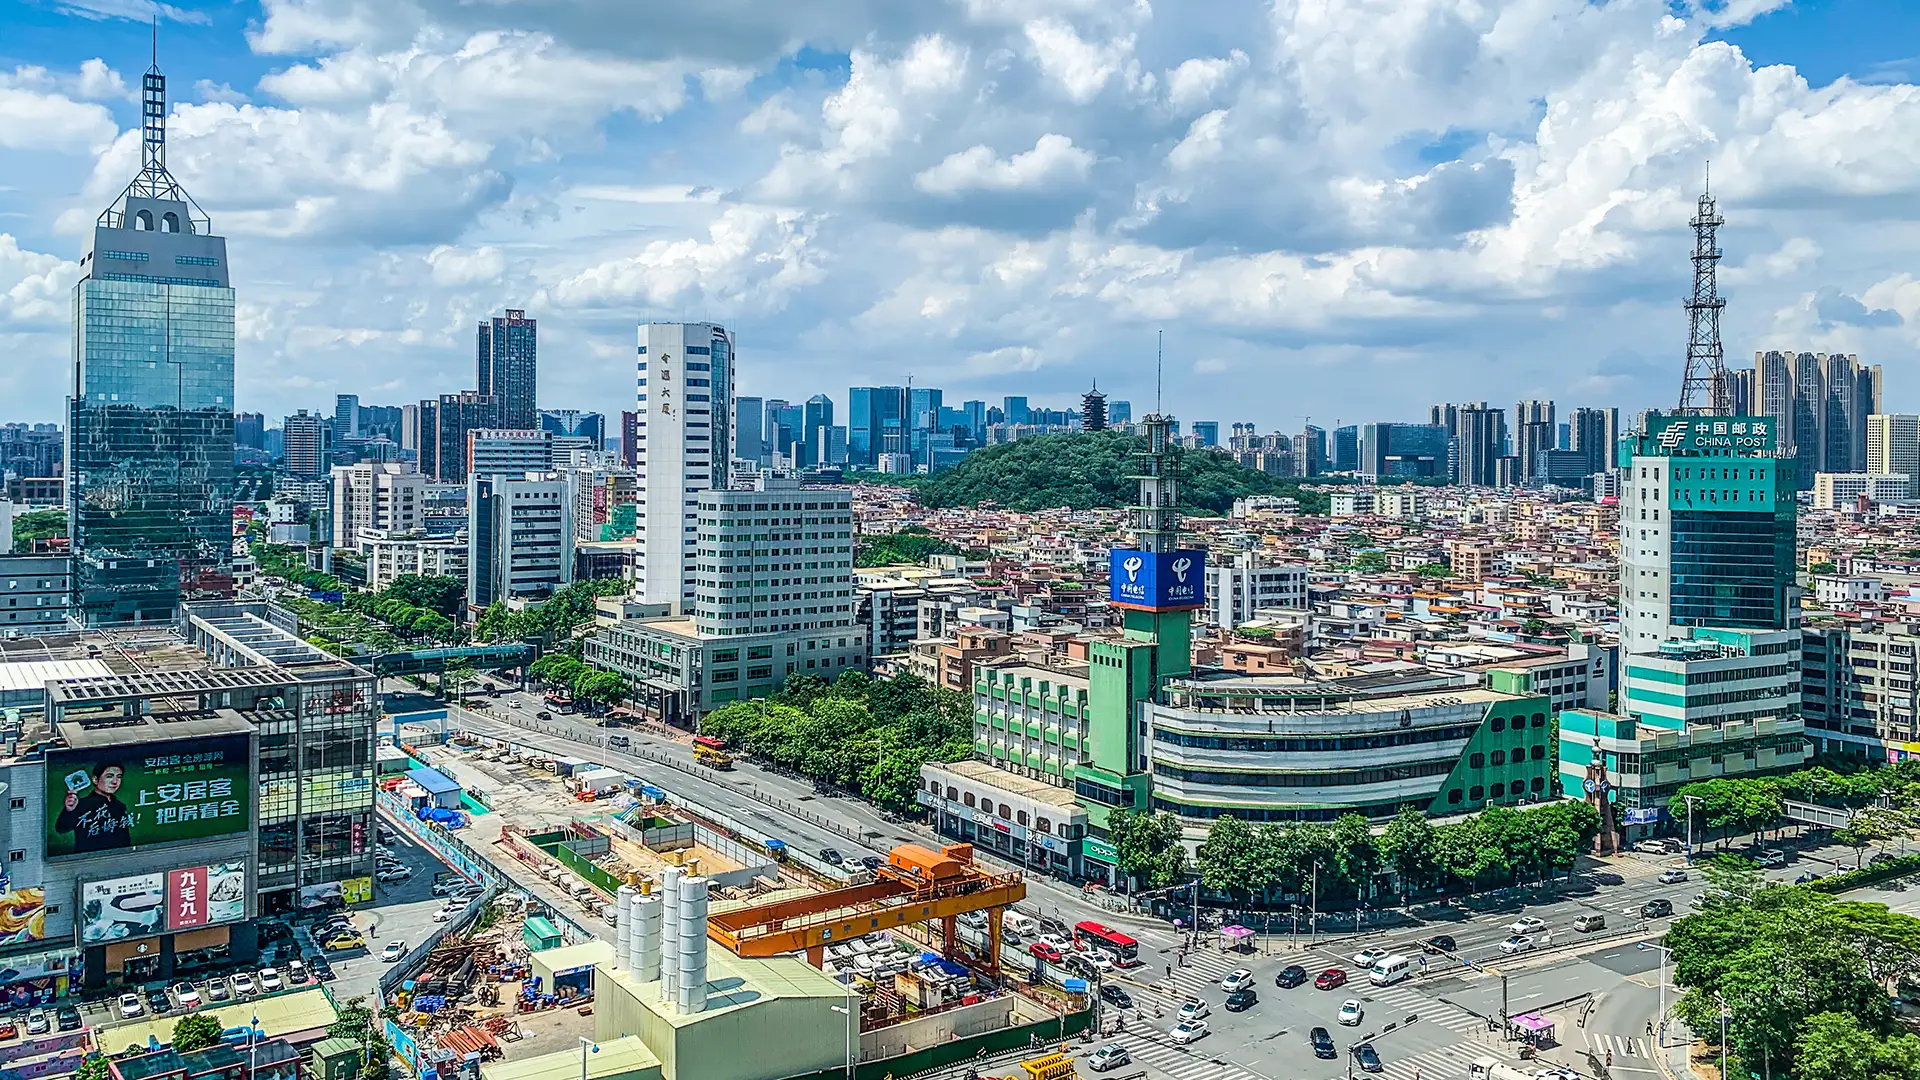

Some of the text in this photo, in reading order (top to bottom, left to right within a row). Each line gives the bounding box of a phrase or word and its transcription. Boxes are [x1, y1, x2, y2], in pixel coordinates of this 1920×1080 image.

[1695, 421, 1768, 436] 中国邮政
[1695, 437, 1768, 447] CHINA POST
[1120, 582, 1145, 596] 中国电信
[1168, 584, 1194, 599] 中国电信
[134, 777, 232, 807] 上安居客
[156, 799, 240, 825] 把房看全
[180, 872, 198, 917] 九毛九
